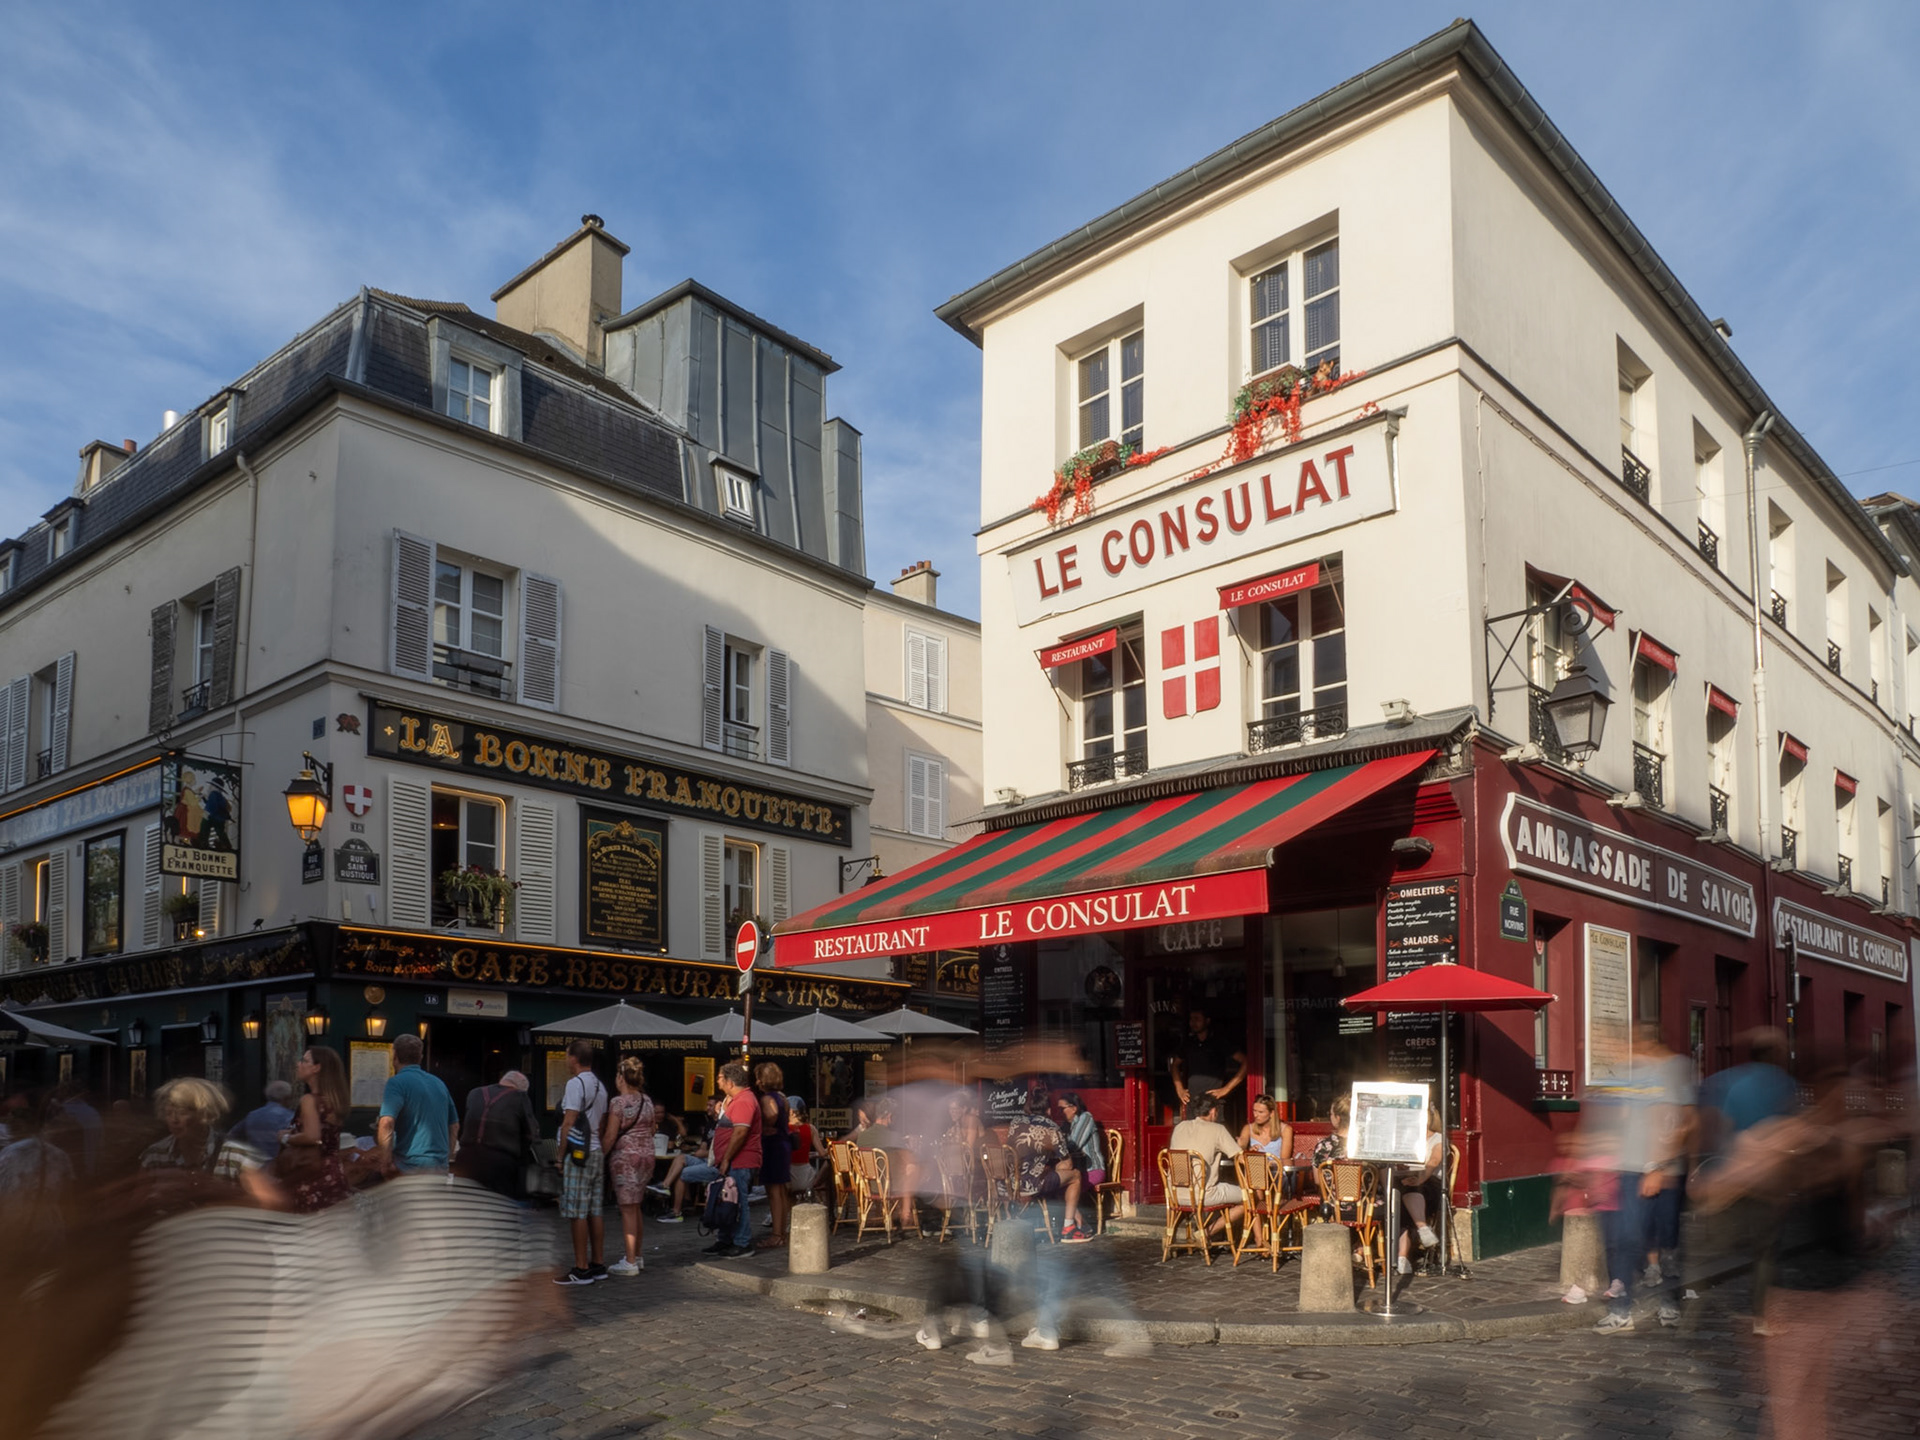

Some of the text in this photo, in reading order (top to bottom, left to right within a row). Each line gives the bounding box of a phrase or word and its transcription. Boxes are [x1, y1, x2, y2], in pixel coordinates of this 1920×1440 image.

[1034, 445, 1354, 600] LE CONSULAT
[1230, 573, 1306, 603] LE CONSULAT
[1051, 638, 1104, 663] RESTAURANT
[400, 716, 834, 834] LA BONNE FRANQUETTE
[63, 769, 160, 827] FRANQUETT
[174, 849, 227, 864] LA BONNE
[350, 855, 364, 863] RUE
[168, 857, 233, 875] FRANQUETTE
[340, 870, 375, 880] RUSTIQUE
[347, 863, 368, 871] SAINT
[1516, 815, 1752, 925] AMBASSADE DE SAVOIE
[1400, 885, 1445, 898] OMELETTES
[979, 884, 1196, 938] LE CONSULAT
[1509, 905, 1519, 917] RUE
[1504, 919, 1524, 932] NORVINS
[813, 926, 930, 958] RESTAURANT
[1403, 935, 1439, 946] SALADES
[1778, 911, 1903, 972] RESTAURANT LE CONSULAT
[451, 947, 549, 985] CAFÉ
[565, 958, 774, 1003] RESTAURAT
[786, 980, 840, 1008] VINS
[619, 1039, 708, 1050] LA BONNE FRANQUETTE
[1405, 1037, 1437, 1047] CRÊPES
